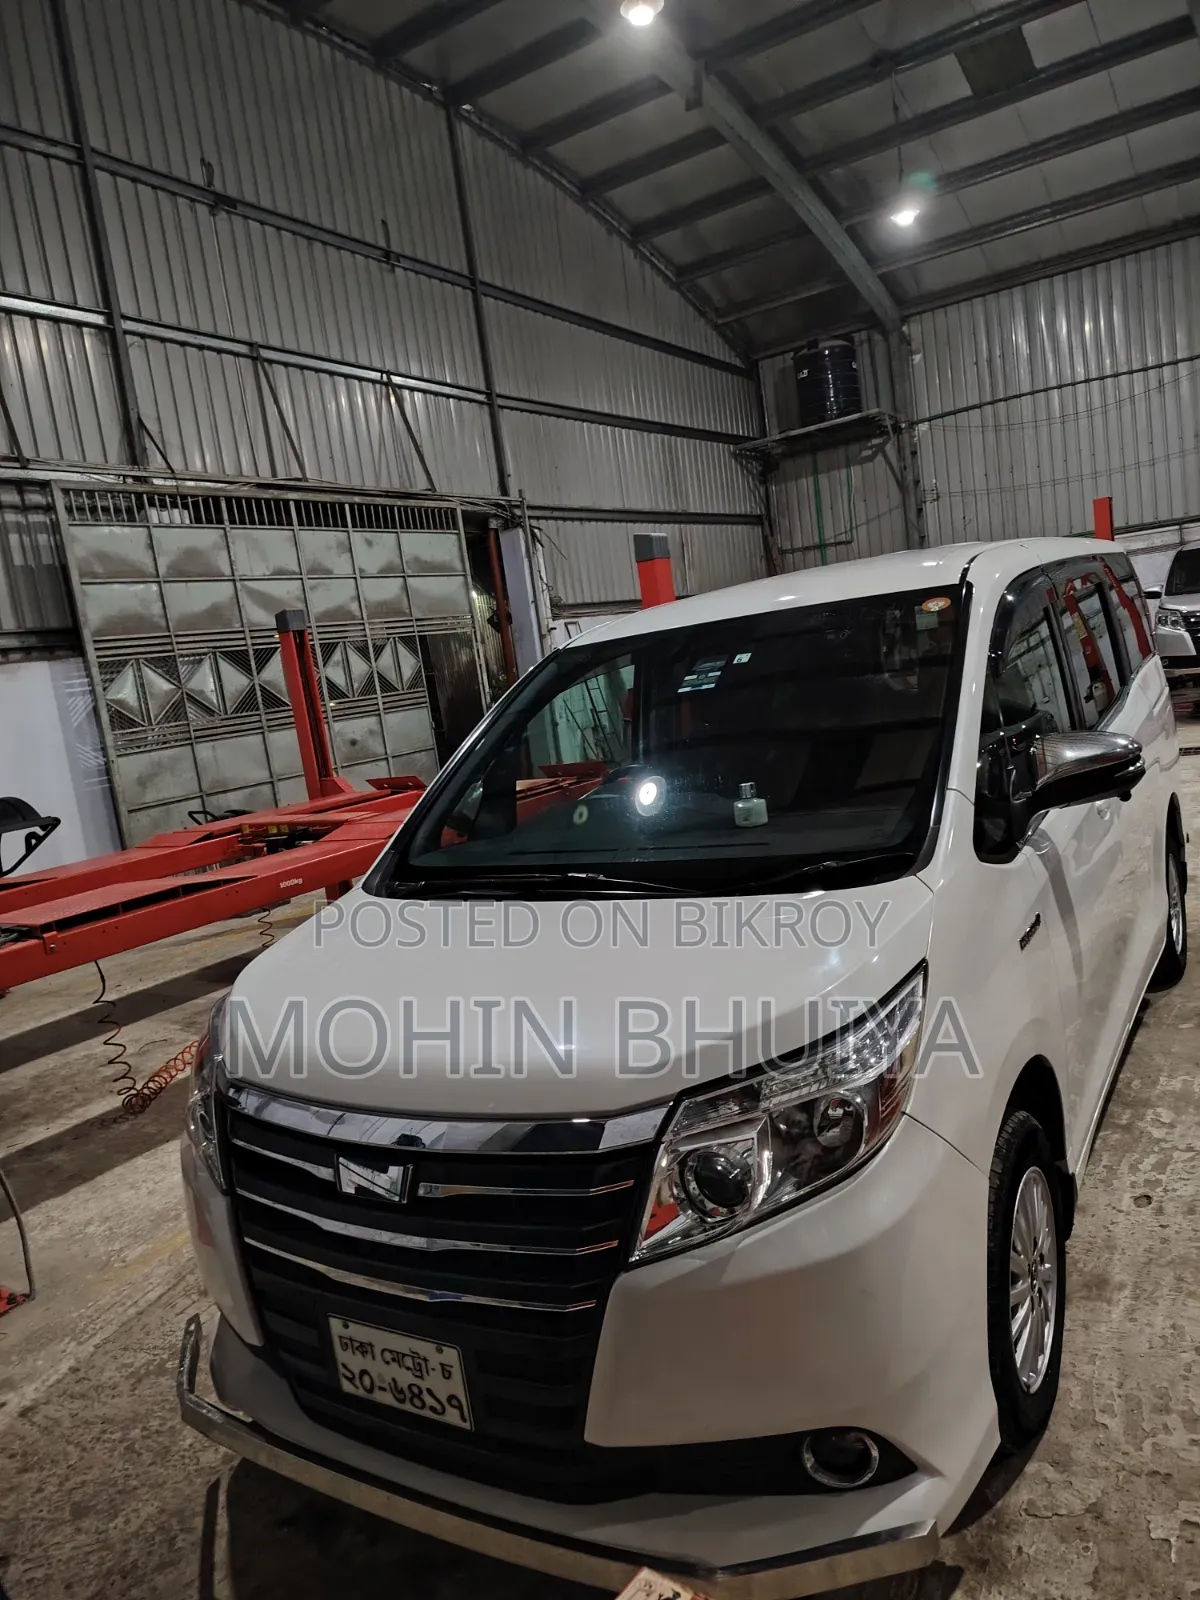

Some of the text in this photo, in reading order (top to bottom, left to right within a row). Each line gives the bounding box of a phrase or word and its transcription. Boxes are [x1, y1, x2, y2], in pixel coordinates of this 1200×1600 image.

[279, 877, 303, 889] 1000kg
[338, 1335, 375, 1360] ঢাকা
[341, 1362, 468, 1423] ২০-৬৪১৭
